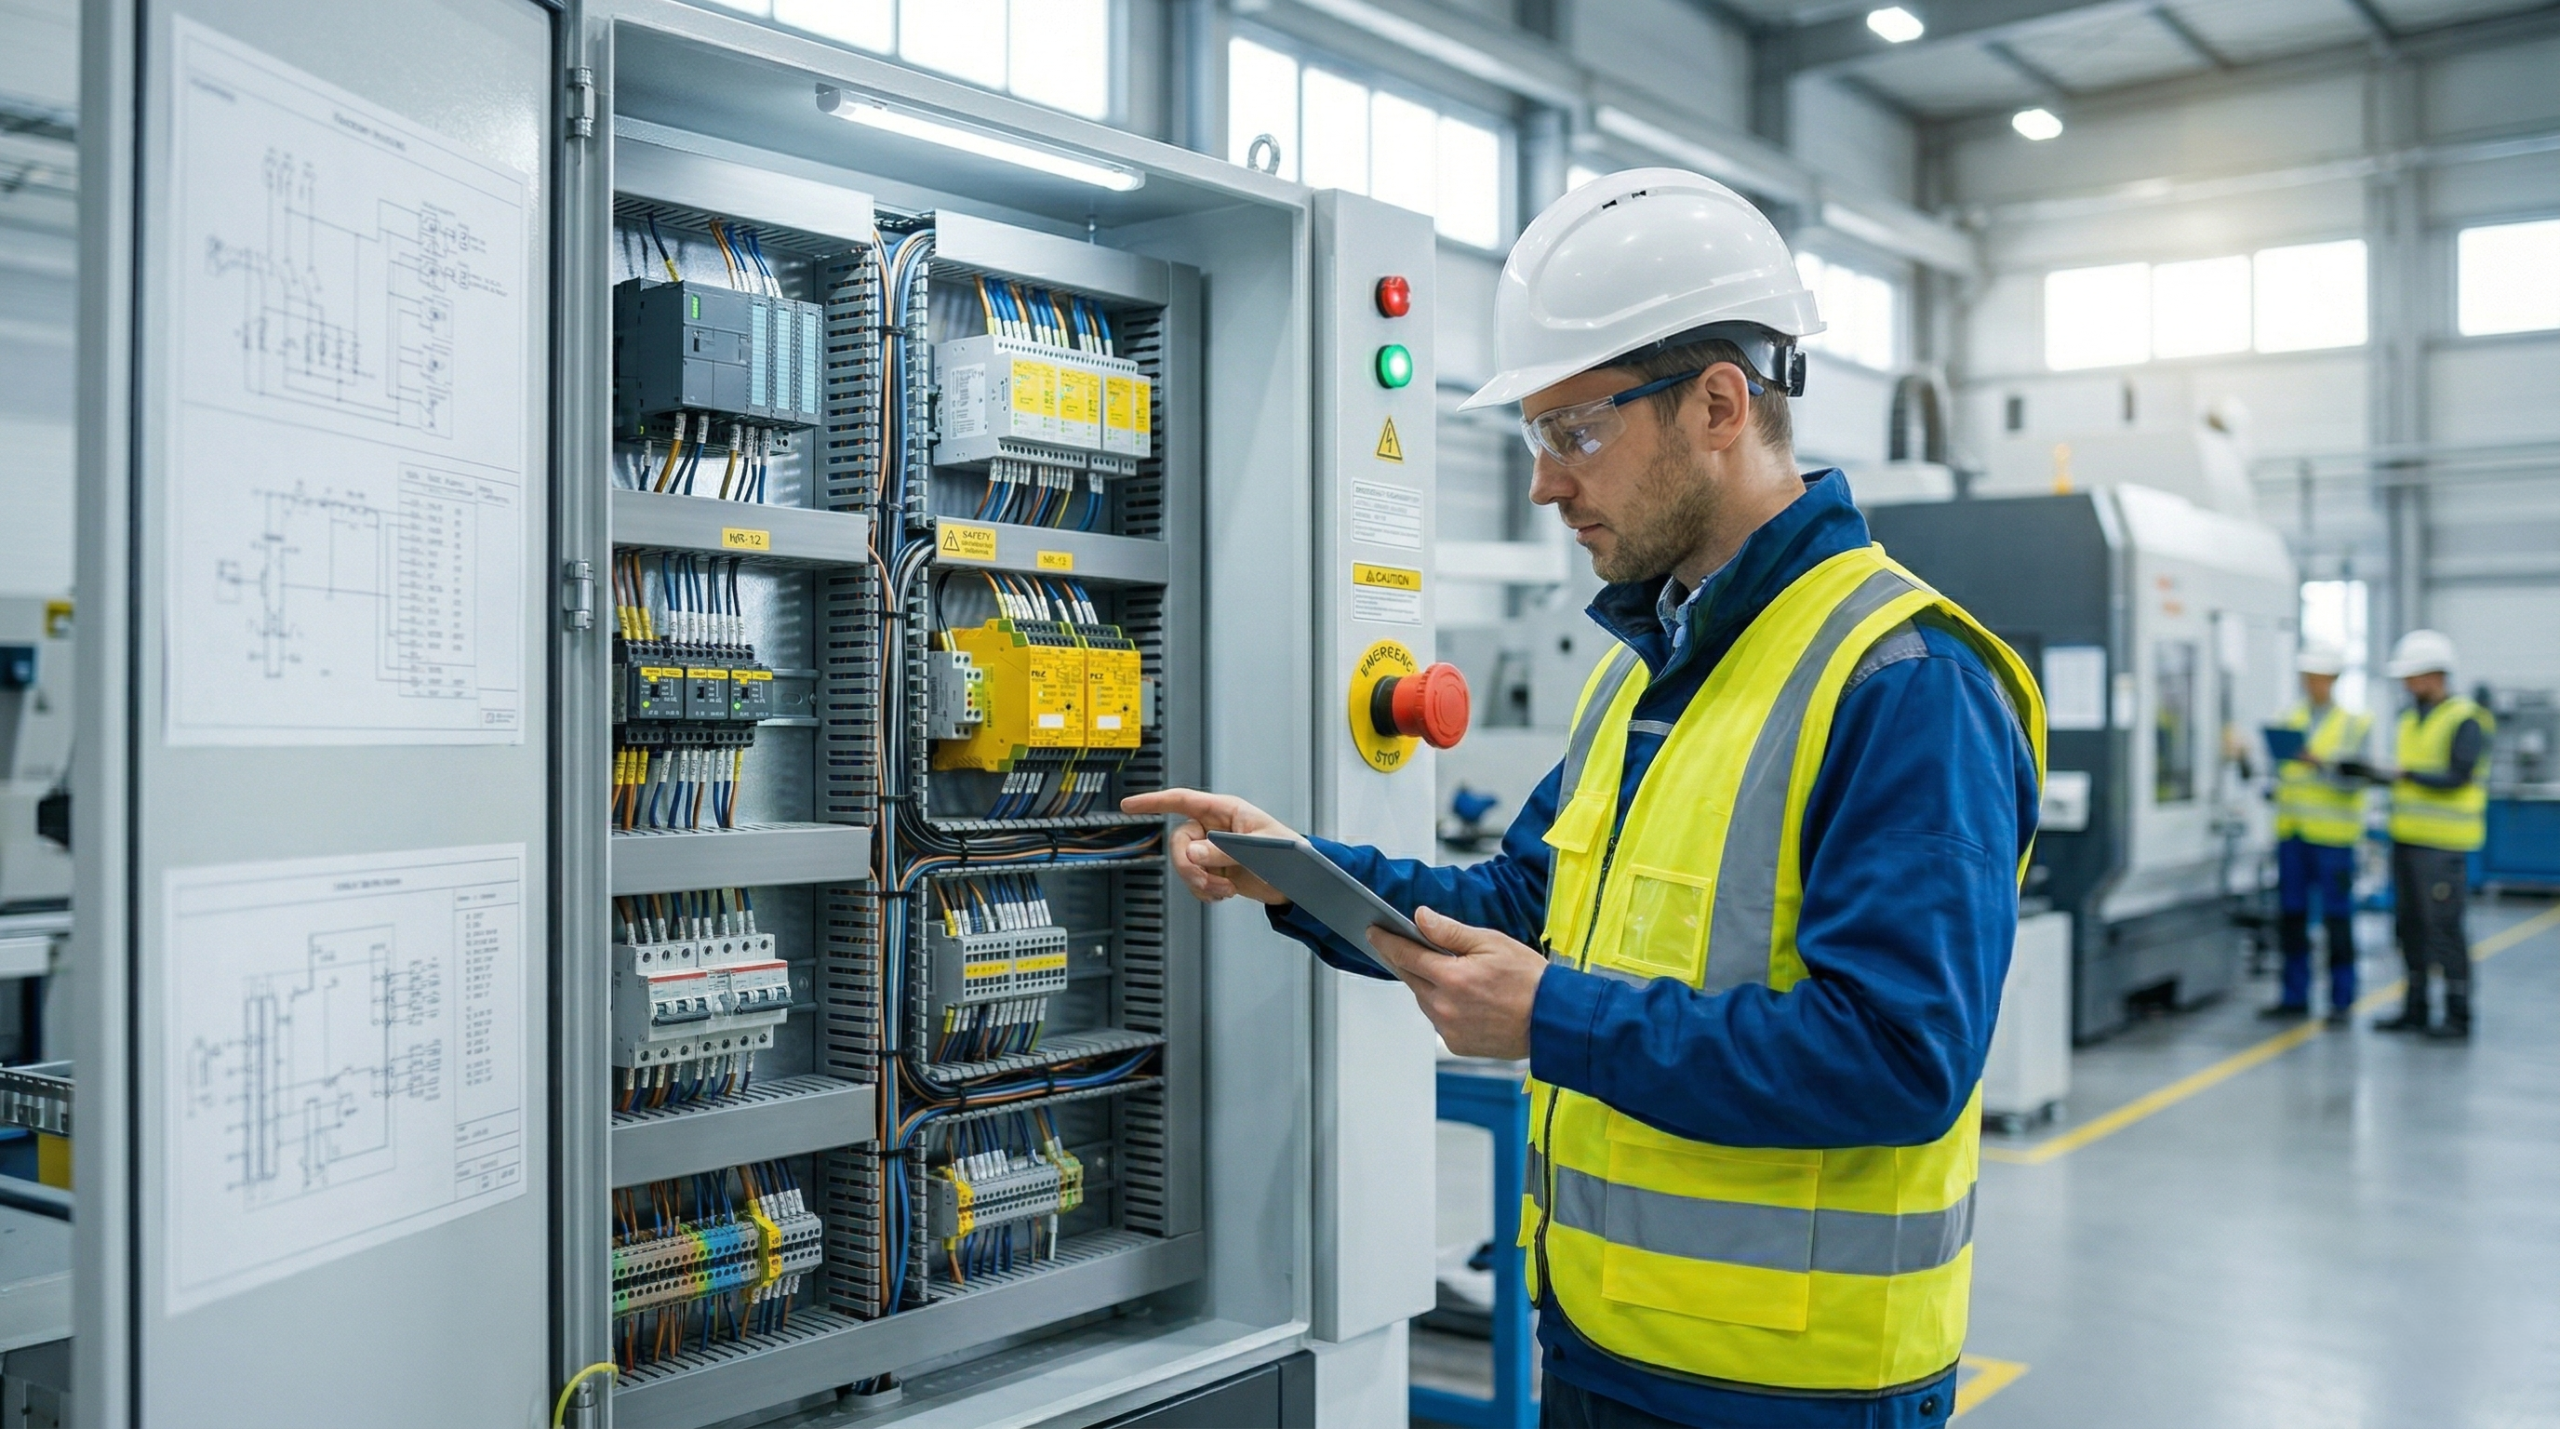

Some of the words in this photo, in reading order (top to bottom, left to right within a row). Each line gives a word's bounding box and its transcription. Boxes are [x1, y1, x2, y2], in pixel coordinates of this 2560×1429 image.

[962, 530, 992, 541] SAFETY
[1375, 571, 1410, 586] CAUTION
[1375, 749, 1401, 766] STOP
